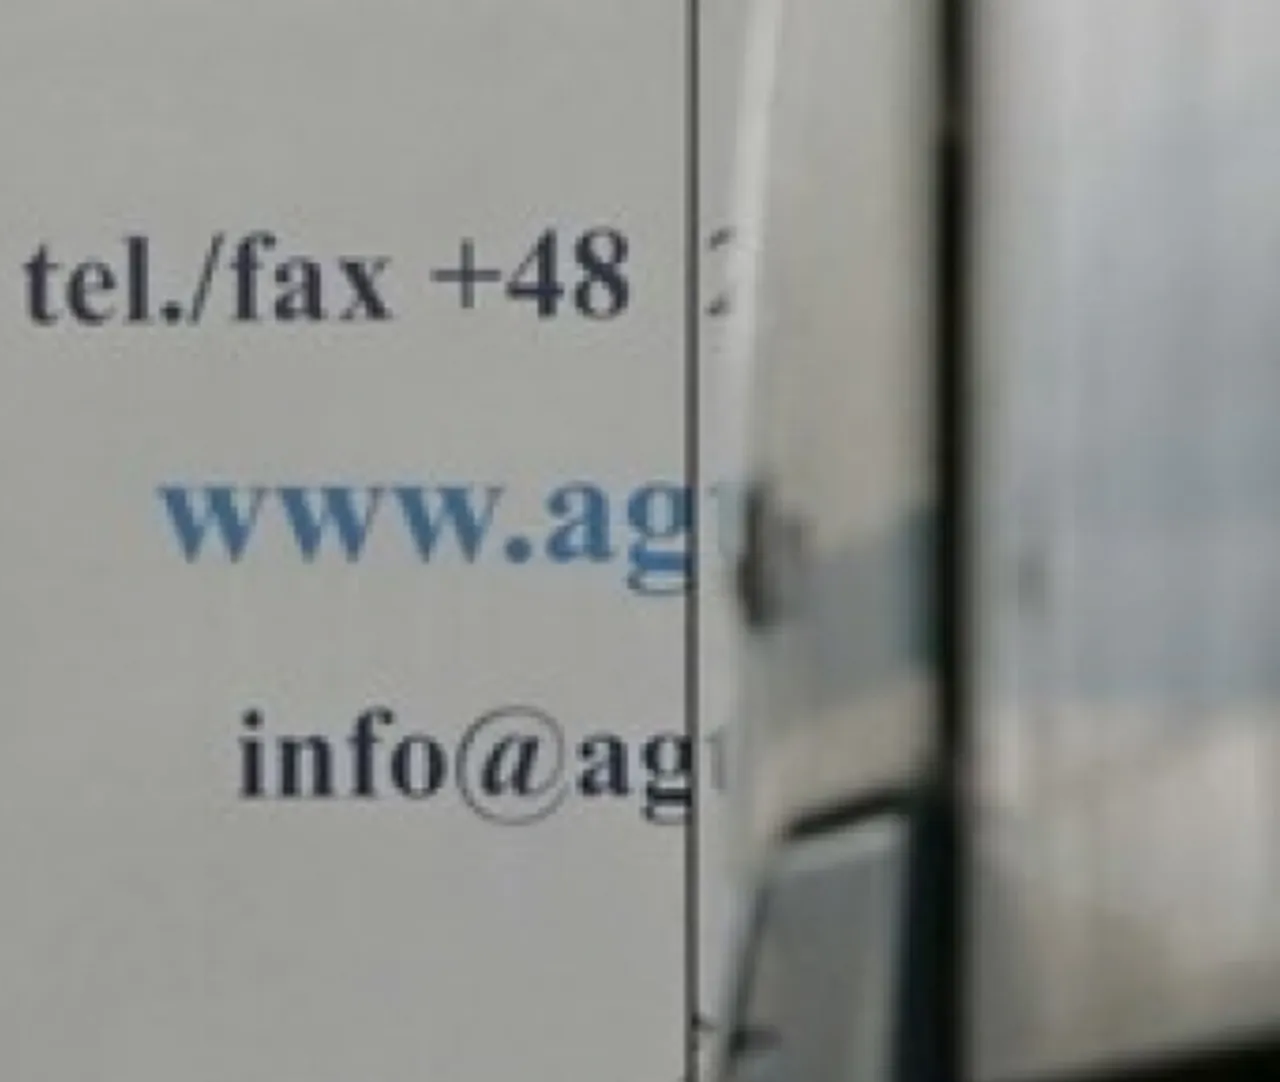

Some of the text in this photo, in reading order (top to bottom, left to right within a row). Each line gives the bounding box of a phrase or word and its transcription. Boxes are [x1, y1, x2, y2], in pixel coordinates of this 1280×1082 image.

[21, 230, 393, 327] tel./fax
[429, 226, 630, 320] +48
[238, 706, 730, 826] info@ag
